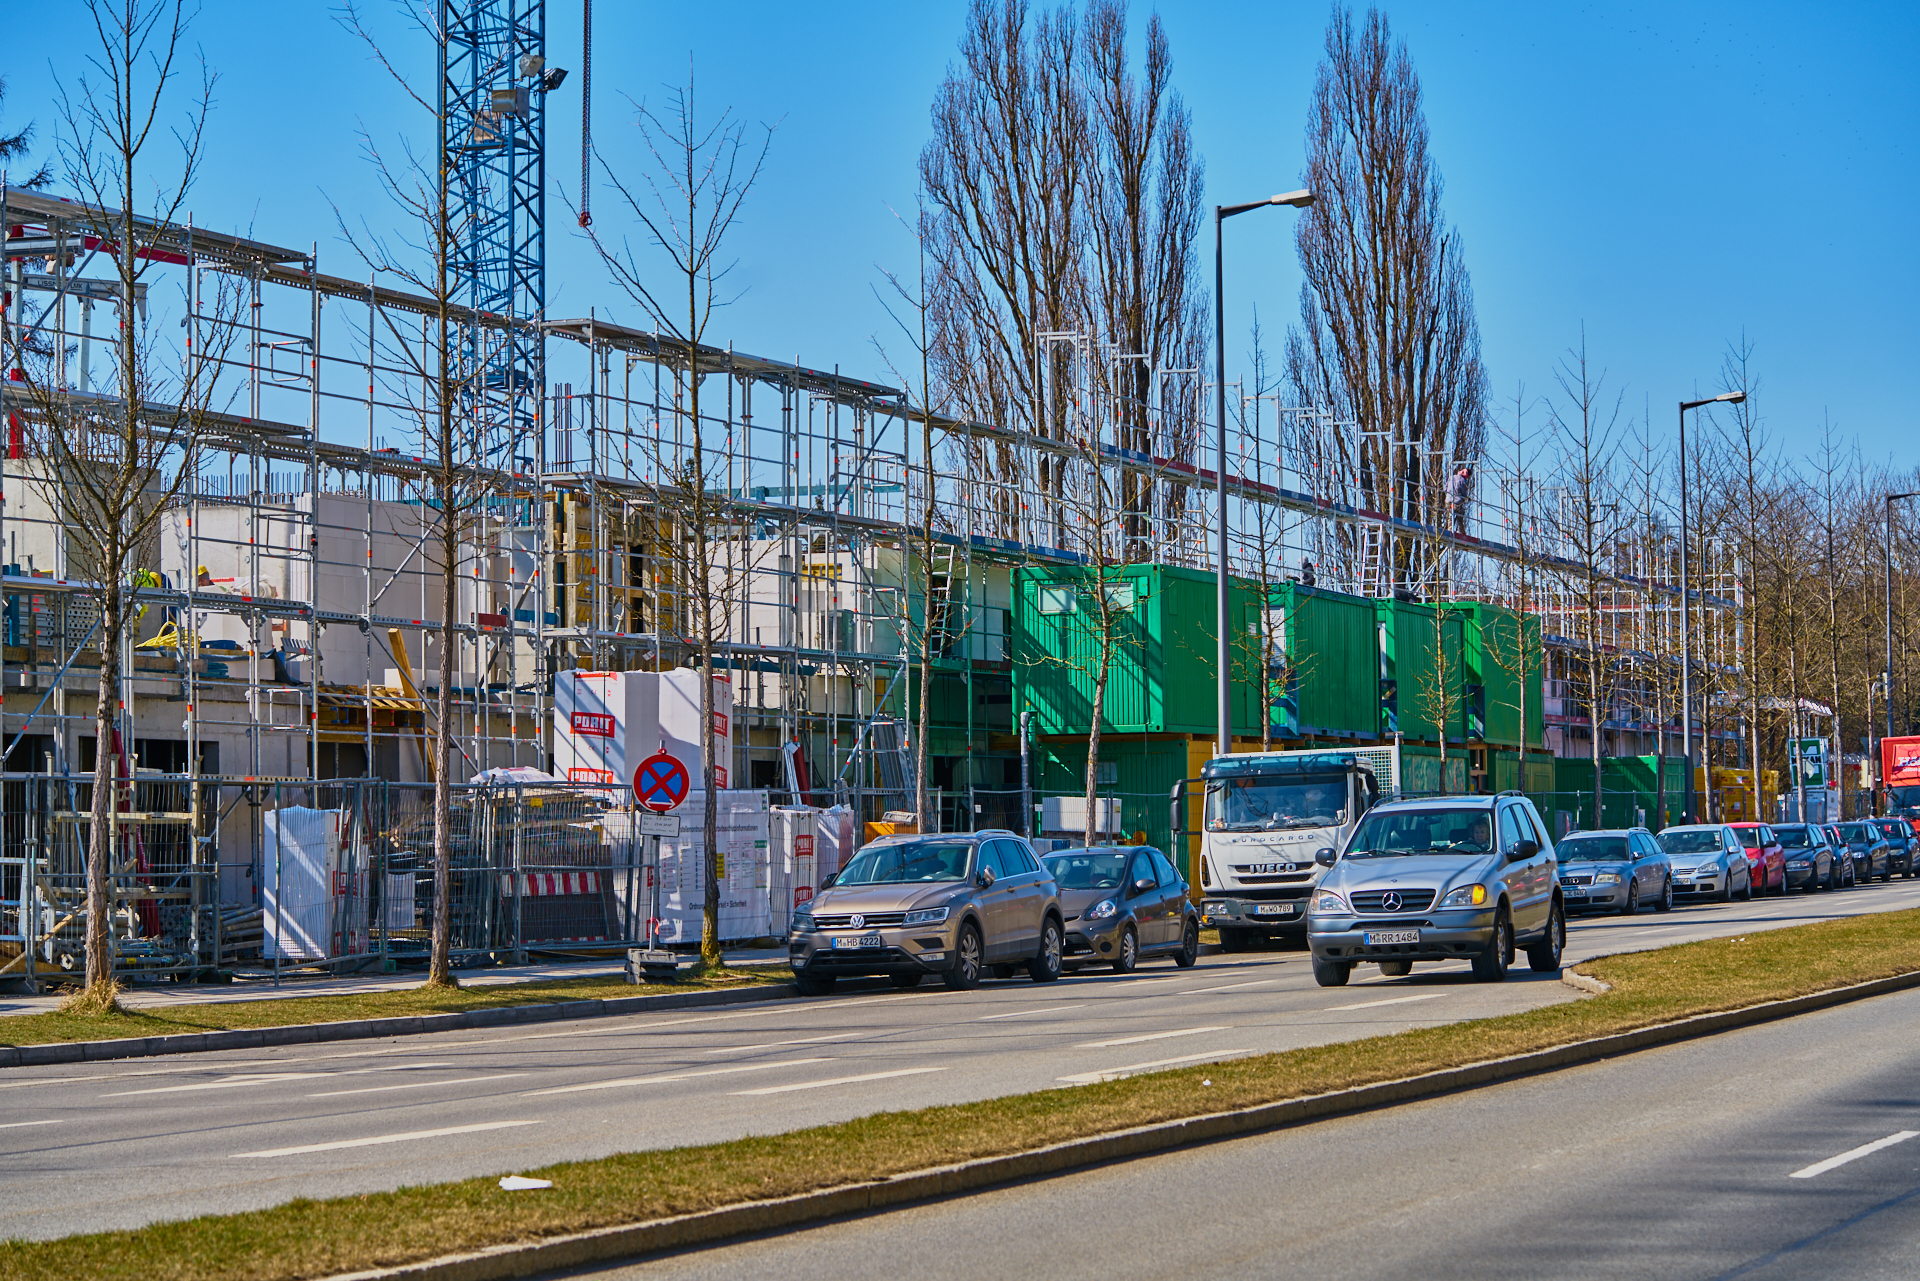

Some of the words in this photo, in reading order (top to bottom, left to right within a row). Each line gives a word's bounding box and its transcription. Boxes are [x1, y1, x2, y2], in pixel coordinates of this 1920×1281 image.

[574, 716, 611, 730] PORIT
[1232, 834, 1314, 843] EUROCARGO
[1249, 863, 1297, 874] IVECO
[836, 938, 842, 947] M
[846, 938, 857, 947] HB
[859, 937, 880, 946] 4222
[1369, 934, 1376, 943] M
[1381, 933, 1394, 943] RR
[1395, 932, 1418, 942] 1484
